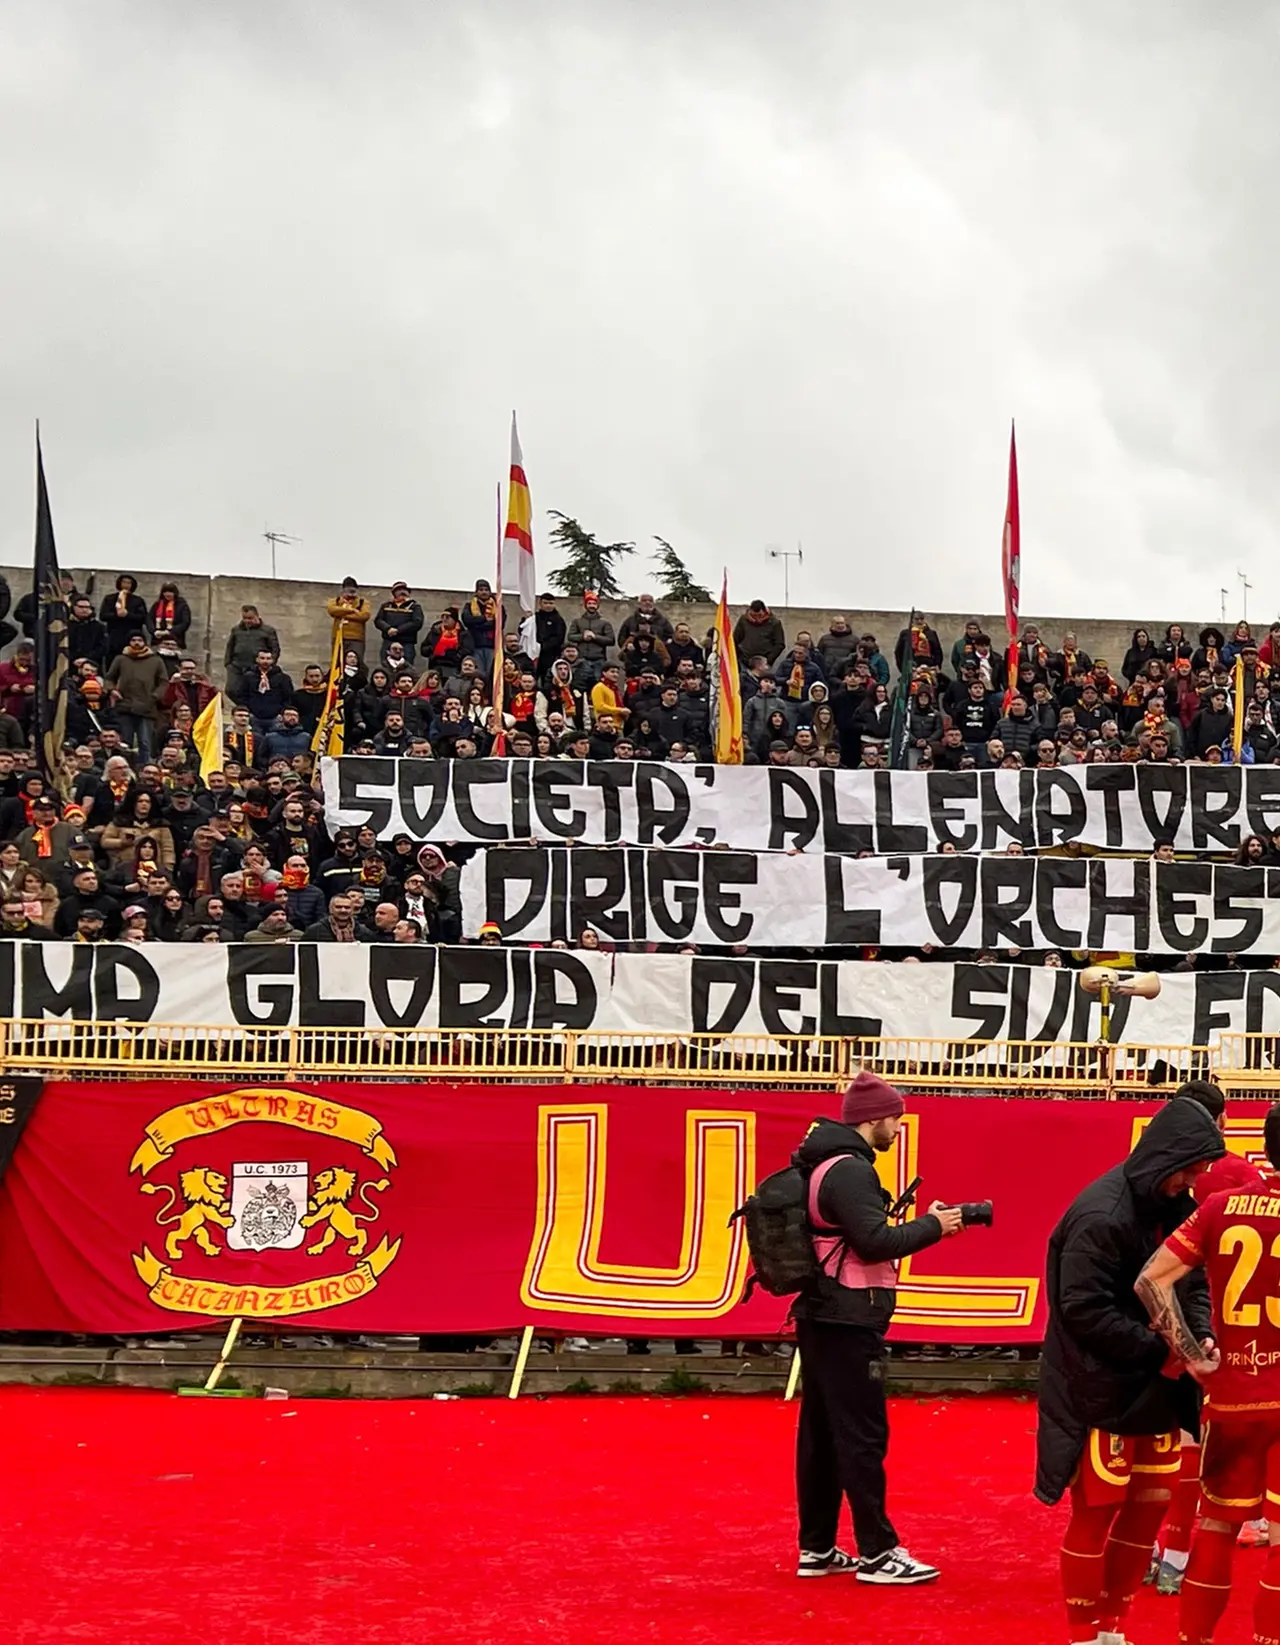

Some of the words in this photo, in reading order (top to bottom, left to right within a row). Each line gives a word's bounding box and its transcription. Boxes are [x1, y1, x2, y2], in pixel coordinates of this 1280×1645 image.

[486, 848, 758, 943] DIRIGE
[227, 943, 598, 1042] GLORIA
[692, 955, 882, 1056] DEL
[185, 1088, 342, 1130] ULTRAS
[271, 1163, 299, 1174] 1973
